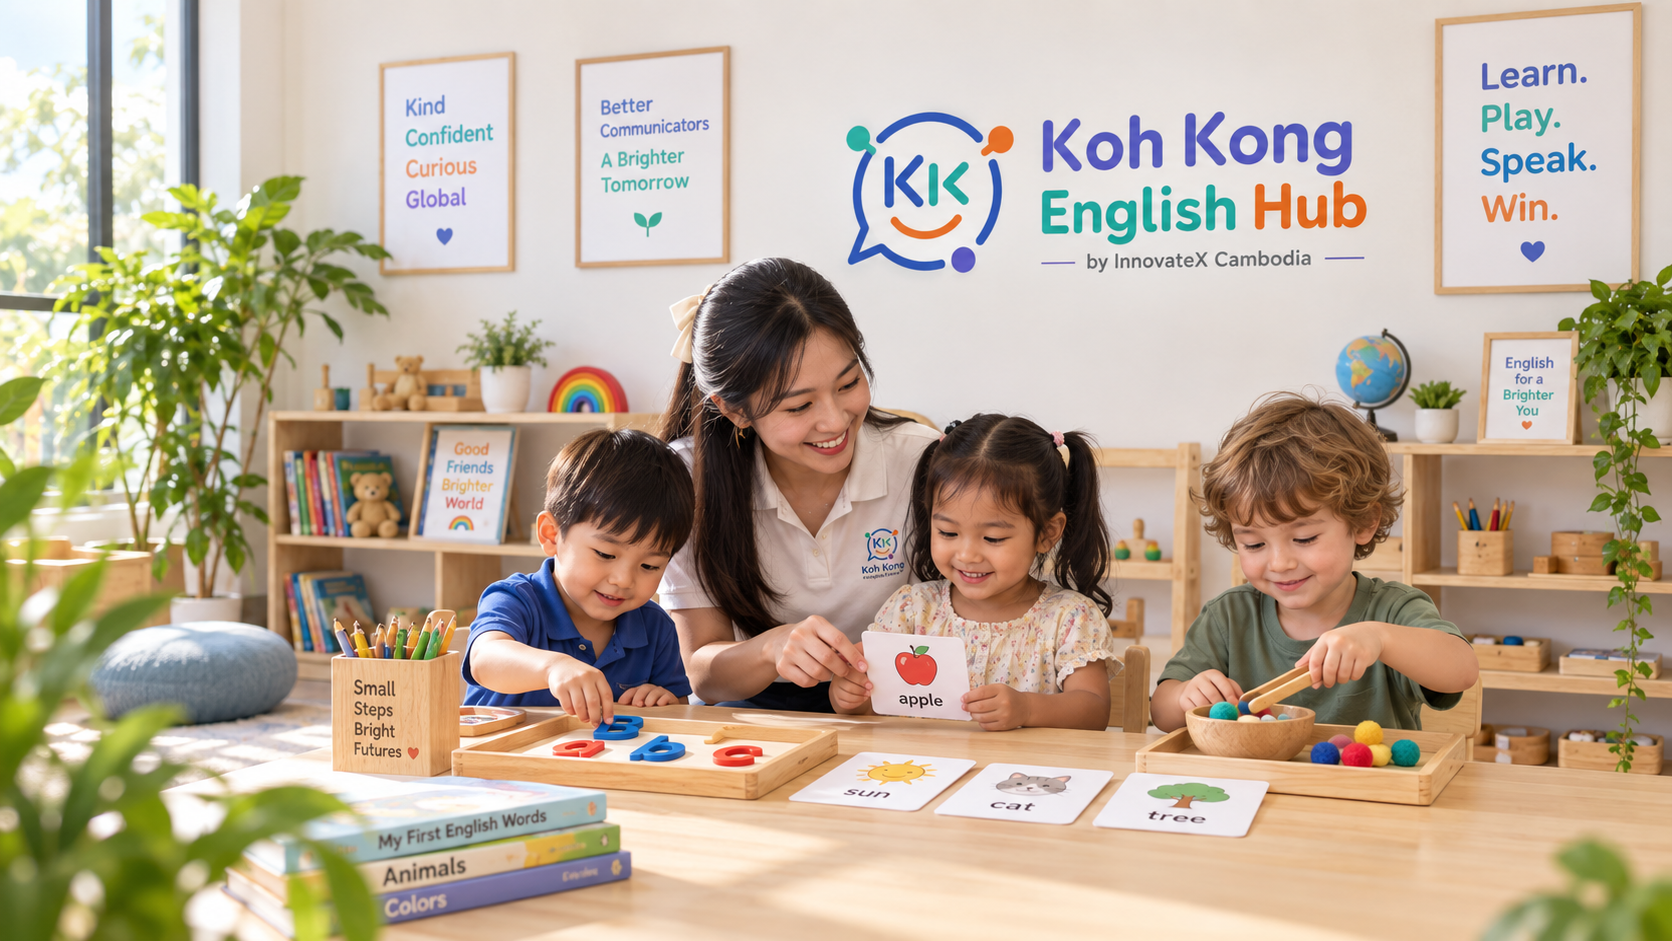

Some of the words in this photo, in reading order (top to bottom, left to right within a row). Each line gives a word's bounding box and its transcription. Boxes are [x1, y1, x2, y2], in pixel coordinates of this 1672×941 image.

[1482, 63, 1587, 90] Learn.
[406, 95, 445, 117] Kind
[601, 98, 653, 115] Better
[600, 118, 710, 139] Communicators
[1482, 103, 1560, 136] Play.
[406, 124, 493, 147] Confident
[1043, 115, 1163, 172] Koh
[1185, 112, 1352, 176] Kong
[406, 157, 477, 178] Curious
[601, 153, 612, 168] A
[618, 149, 684, 169] Brighter
[1481, 142, 1596, 183] Speak.
[601, 176, 689, 193] Tomorrow
[885, 155, 969, 208] KK
[406, 187, 466, 209] Global
[1042, 184, 1235, 245] English
[1255, 181, 1367, 230] Hub
[1482, 193, 1558, 222] Win.
[1087, 254, 1108, 273] by
[1115, 252, 1207, 268] InnovateX
[1215, 250, 1311, 267] Cambodia
[1505, 356, 1554, 372] English
[1515, 373, 1533, 384] for
[1536, 376, 1543, 384] a
[1503, 389, 1554, 404] Brighter
[1516, 405, 1538, 416] You
[453, 442, 490, 456] Good
[446, 460, 494, 475] Friends
[442, 478, 493, 494] Brighter
[445, 496, 484, 511] World
[873, 538, 891, 549] KK
[862, 565, 880, 574] Koh
[354, 679, 395, 696] Small
[899, 693, 942, 708] apple
[354, 701, 393, 720] Steps
[355, 722, 395, 740] Bright
[354, 742, 402, 758] Futures
[843, 787, 890, 799] sun
[990, 800, 1036, 812] cat
[1148, 809, 1206, 825] tree
[379, 834, 400, 850] My
[407, 825, 441, 844] First
[446, 816, 498, 838] English
[502, 810, 547, 829] Words
[383, 856, 466, 886] Animals
[384, 893, 447, 918] Colors
